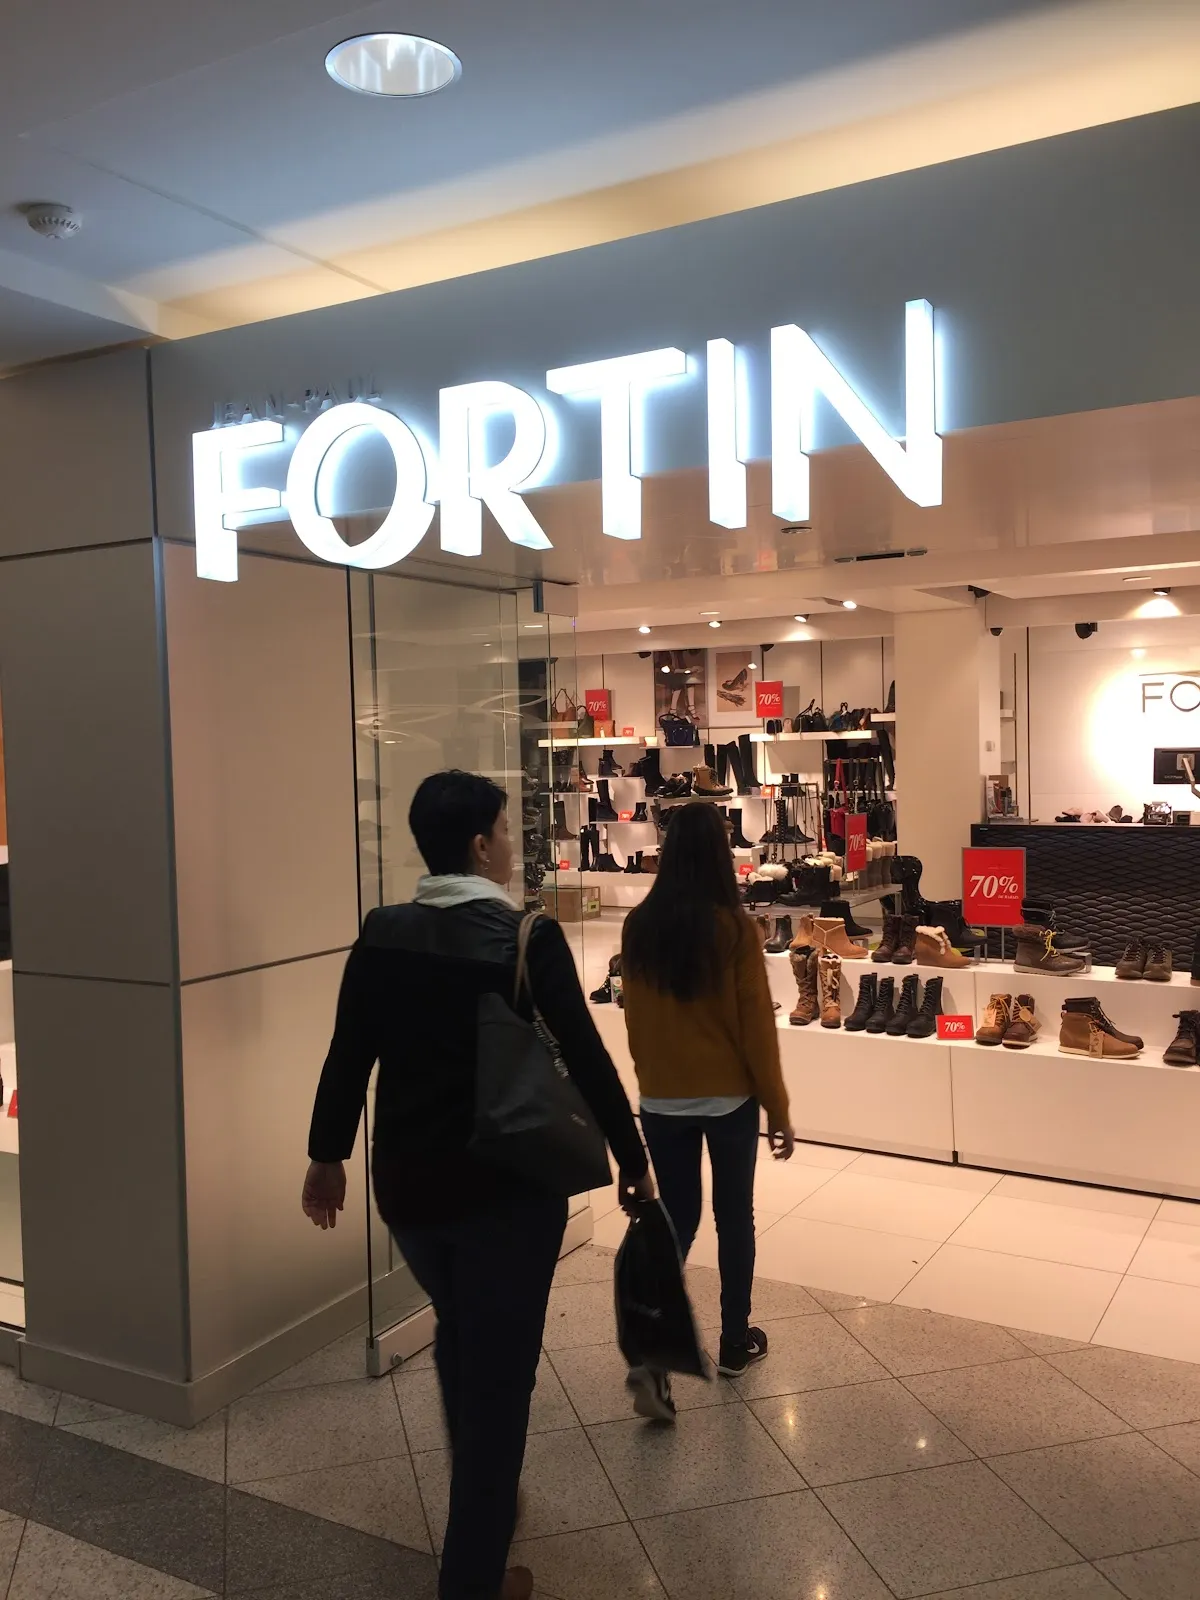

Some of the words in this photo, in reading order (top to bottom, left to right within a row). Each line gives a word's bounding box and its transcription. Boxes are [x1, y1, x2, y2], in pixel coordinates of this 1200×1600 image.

[192, 298, 943, 582] FORTIN
[588, 700, 607, 712] 70%
[758, 693, 781, 706] 70%
[848, 833, 865, 852] 70%
[969, 875, 1019, 899] 70%
[944, 1021, 966, 1033] 70%
